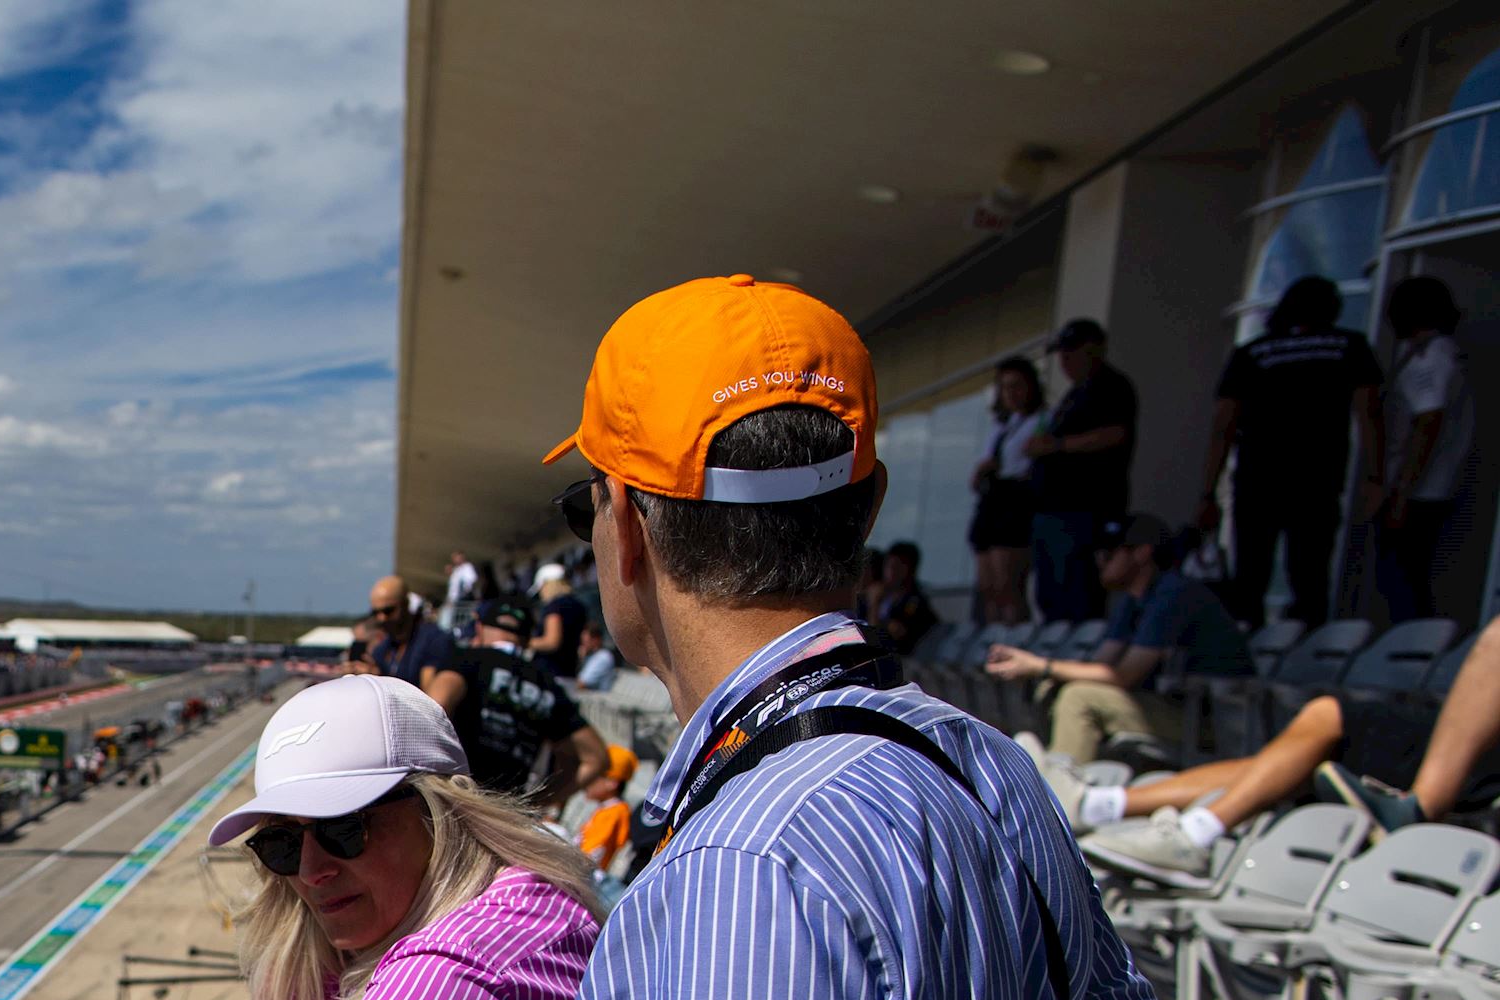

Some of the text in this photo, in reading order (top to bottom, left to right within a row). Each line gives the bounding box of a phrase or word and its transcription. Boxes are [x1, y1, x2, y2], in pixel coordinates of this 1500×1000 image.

[712, 371, 845, 403] GIVES YOU WINGS
[264, 720, 326, 760] F1
[691, 758, 716, 792] PADDOCK
[692, 775, 708, 794] CLUB
